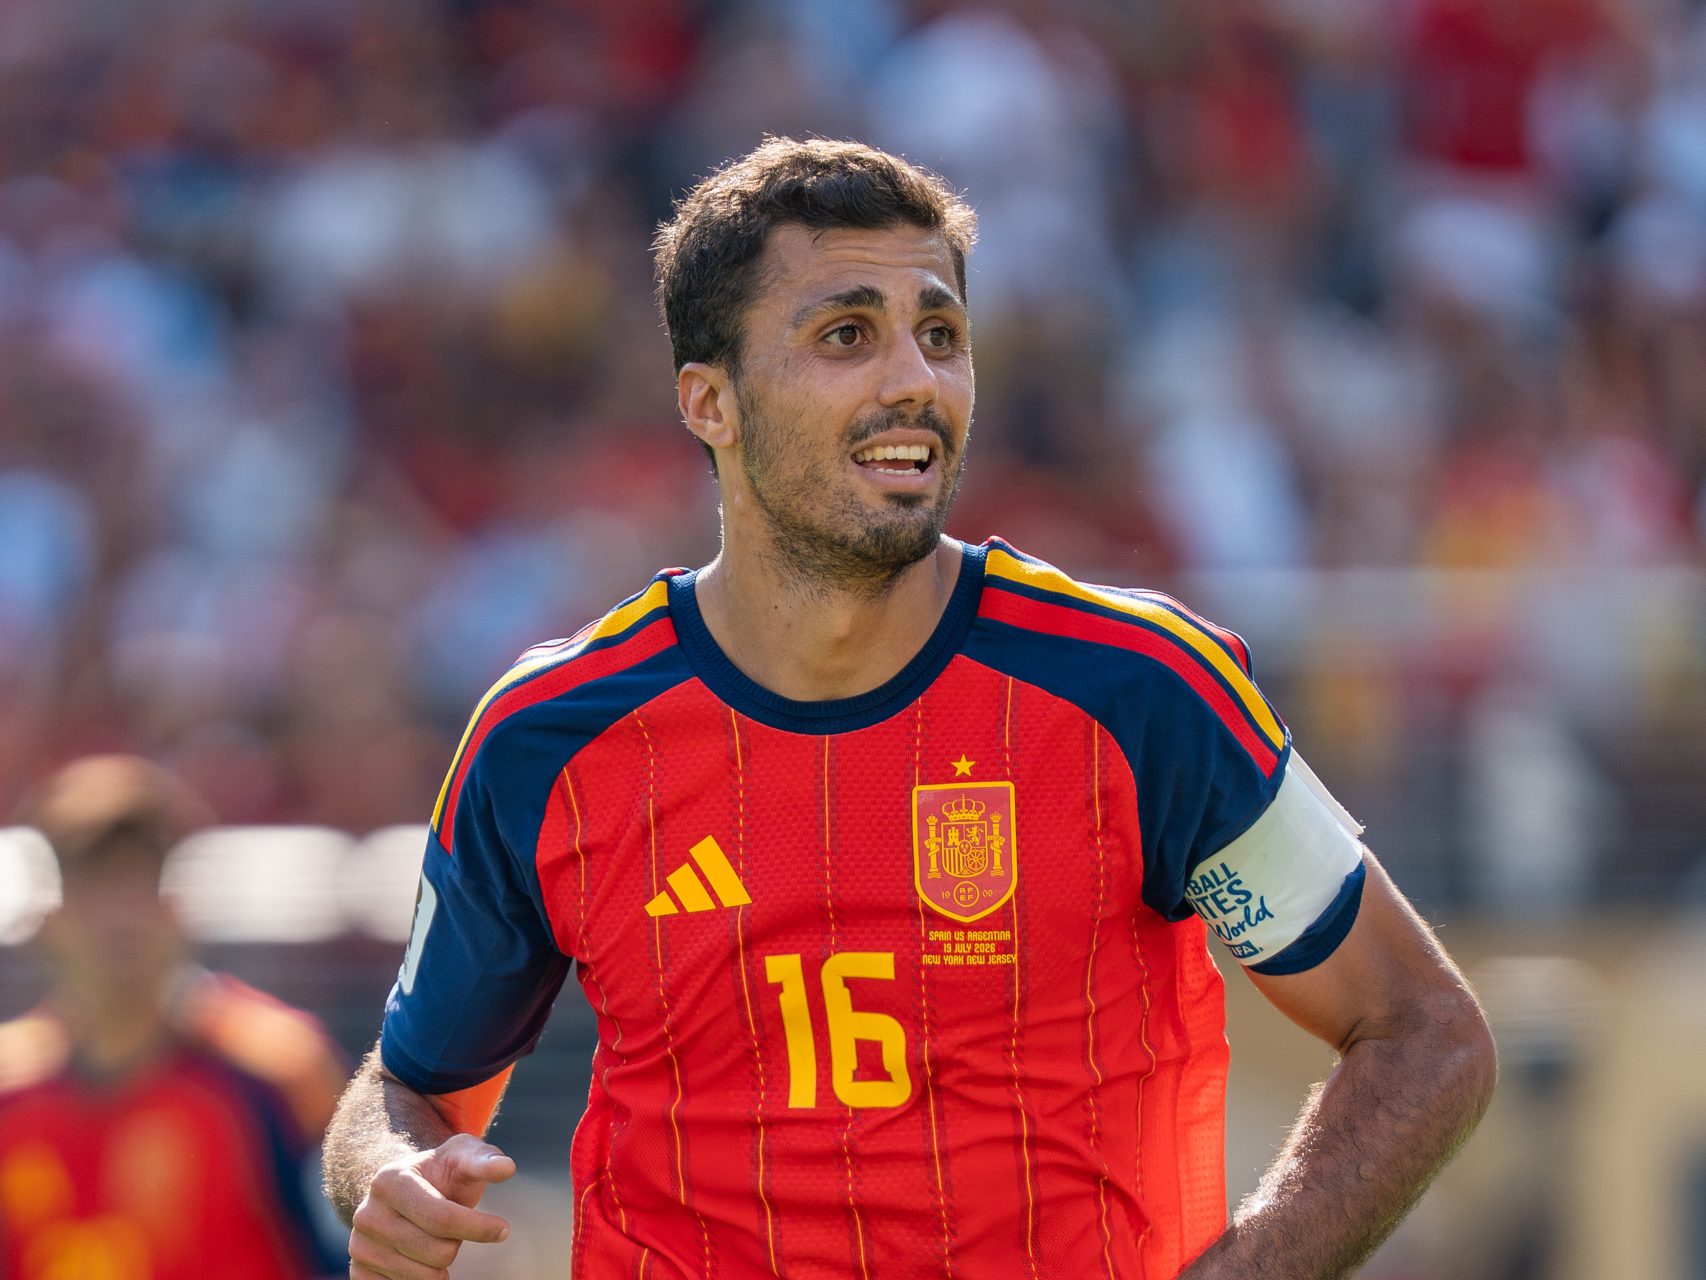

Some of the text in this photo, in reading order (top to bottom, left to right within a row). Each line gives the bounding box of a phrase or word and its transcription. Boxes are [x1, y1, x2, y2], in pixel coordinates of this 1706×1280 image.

[941, 891, 951, 899] 19
[982, 890, 993, 898] 09
[929, 931, 952, 941] SPAIN
[967, 931, 1011, 941] ARGENTINA
[943, 943, 996, 953] 19 JULY 2026
[922, 954, 1017, 965] NEW YORK NEW JERSEY
[765, 952, 912, 1108] 16
